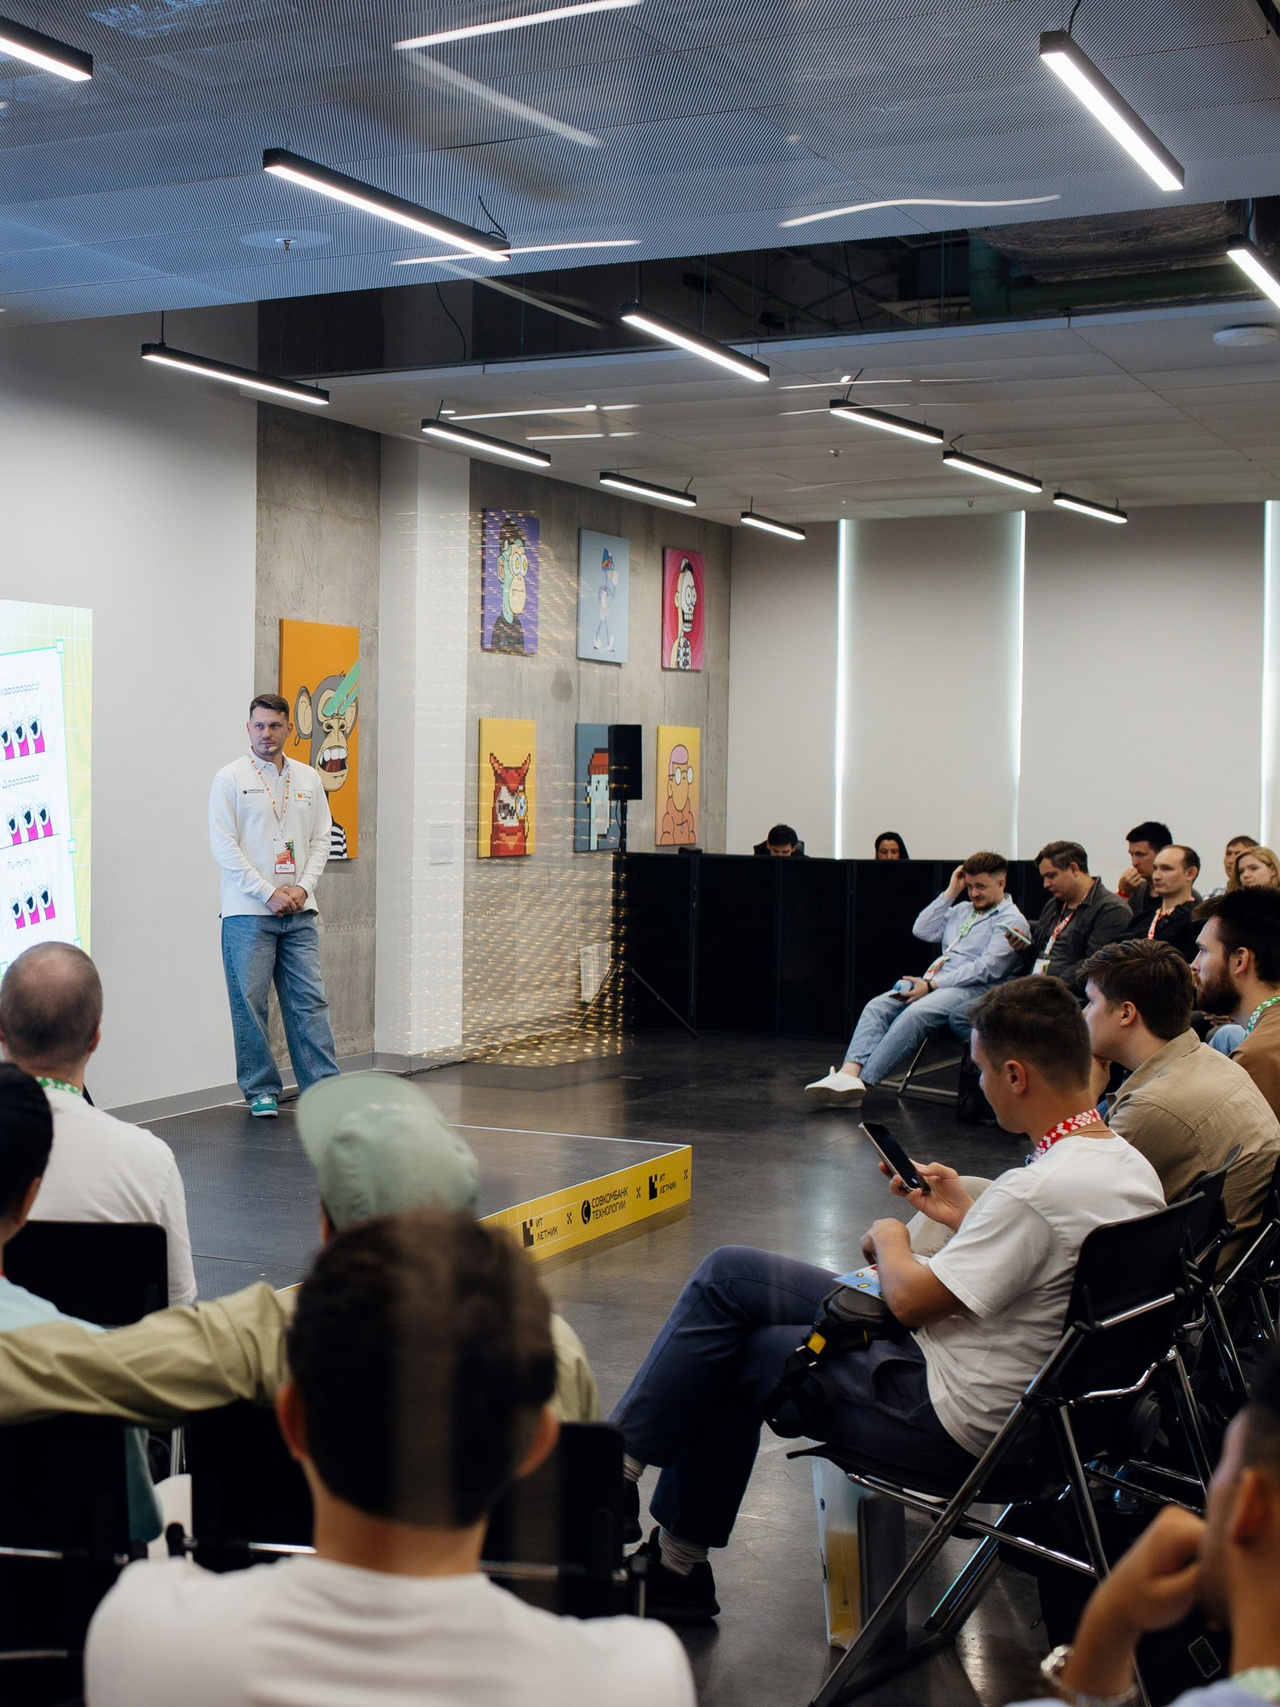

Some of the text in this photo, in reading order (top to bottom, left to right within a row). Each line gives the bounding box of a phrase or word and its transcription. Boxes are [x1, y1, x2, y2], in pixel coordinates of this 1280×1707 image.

[591, 1186, 629, 1209] СОВКОМБАНК
[592, 1199, 626, 1220] ТЕХНОЛОГИИ
[536, 1226, 559, 1241] ЛЕТНИК
